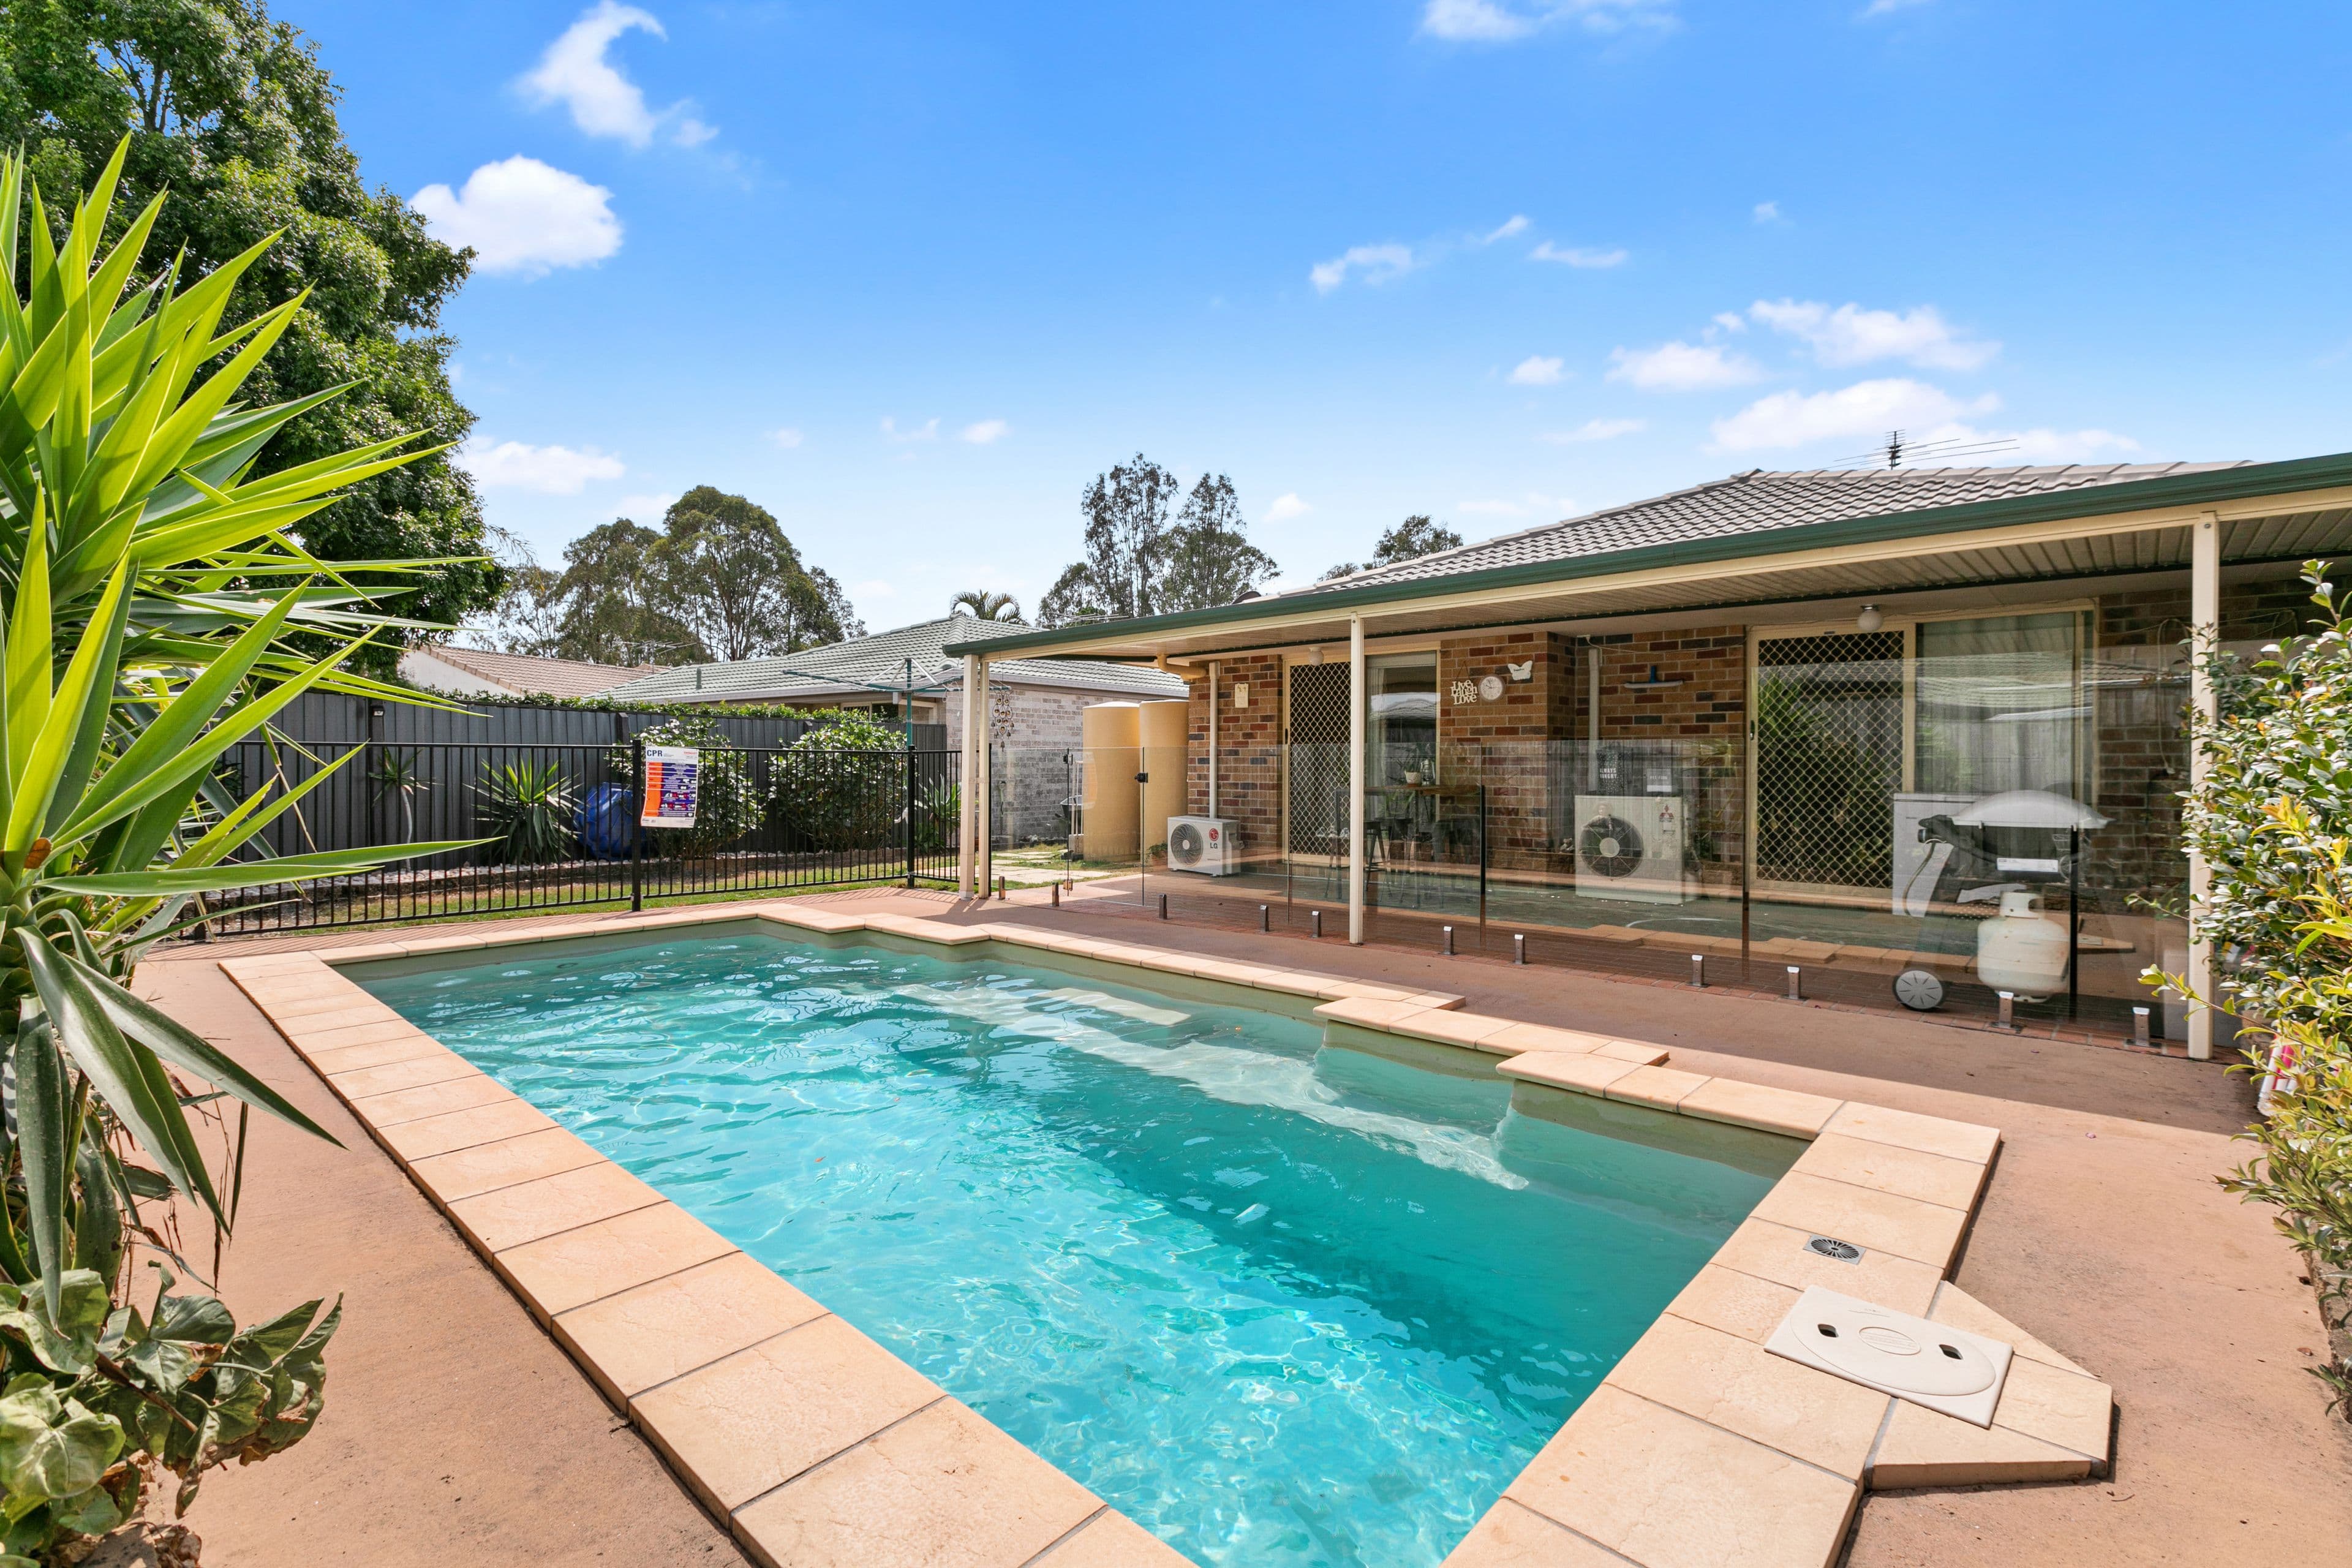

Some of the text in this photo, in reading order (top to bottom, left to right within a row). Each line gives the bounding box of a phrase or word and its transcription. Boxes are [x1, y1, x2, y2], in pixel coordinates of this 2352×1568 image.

[1450, 683, 1477, 696] Laugh
[1452, 680, 1472, 690] Live
[1453, 695, 1477, 704] Love
